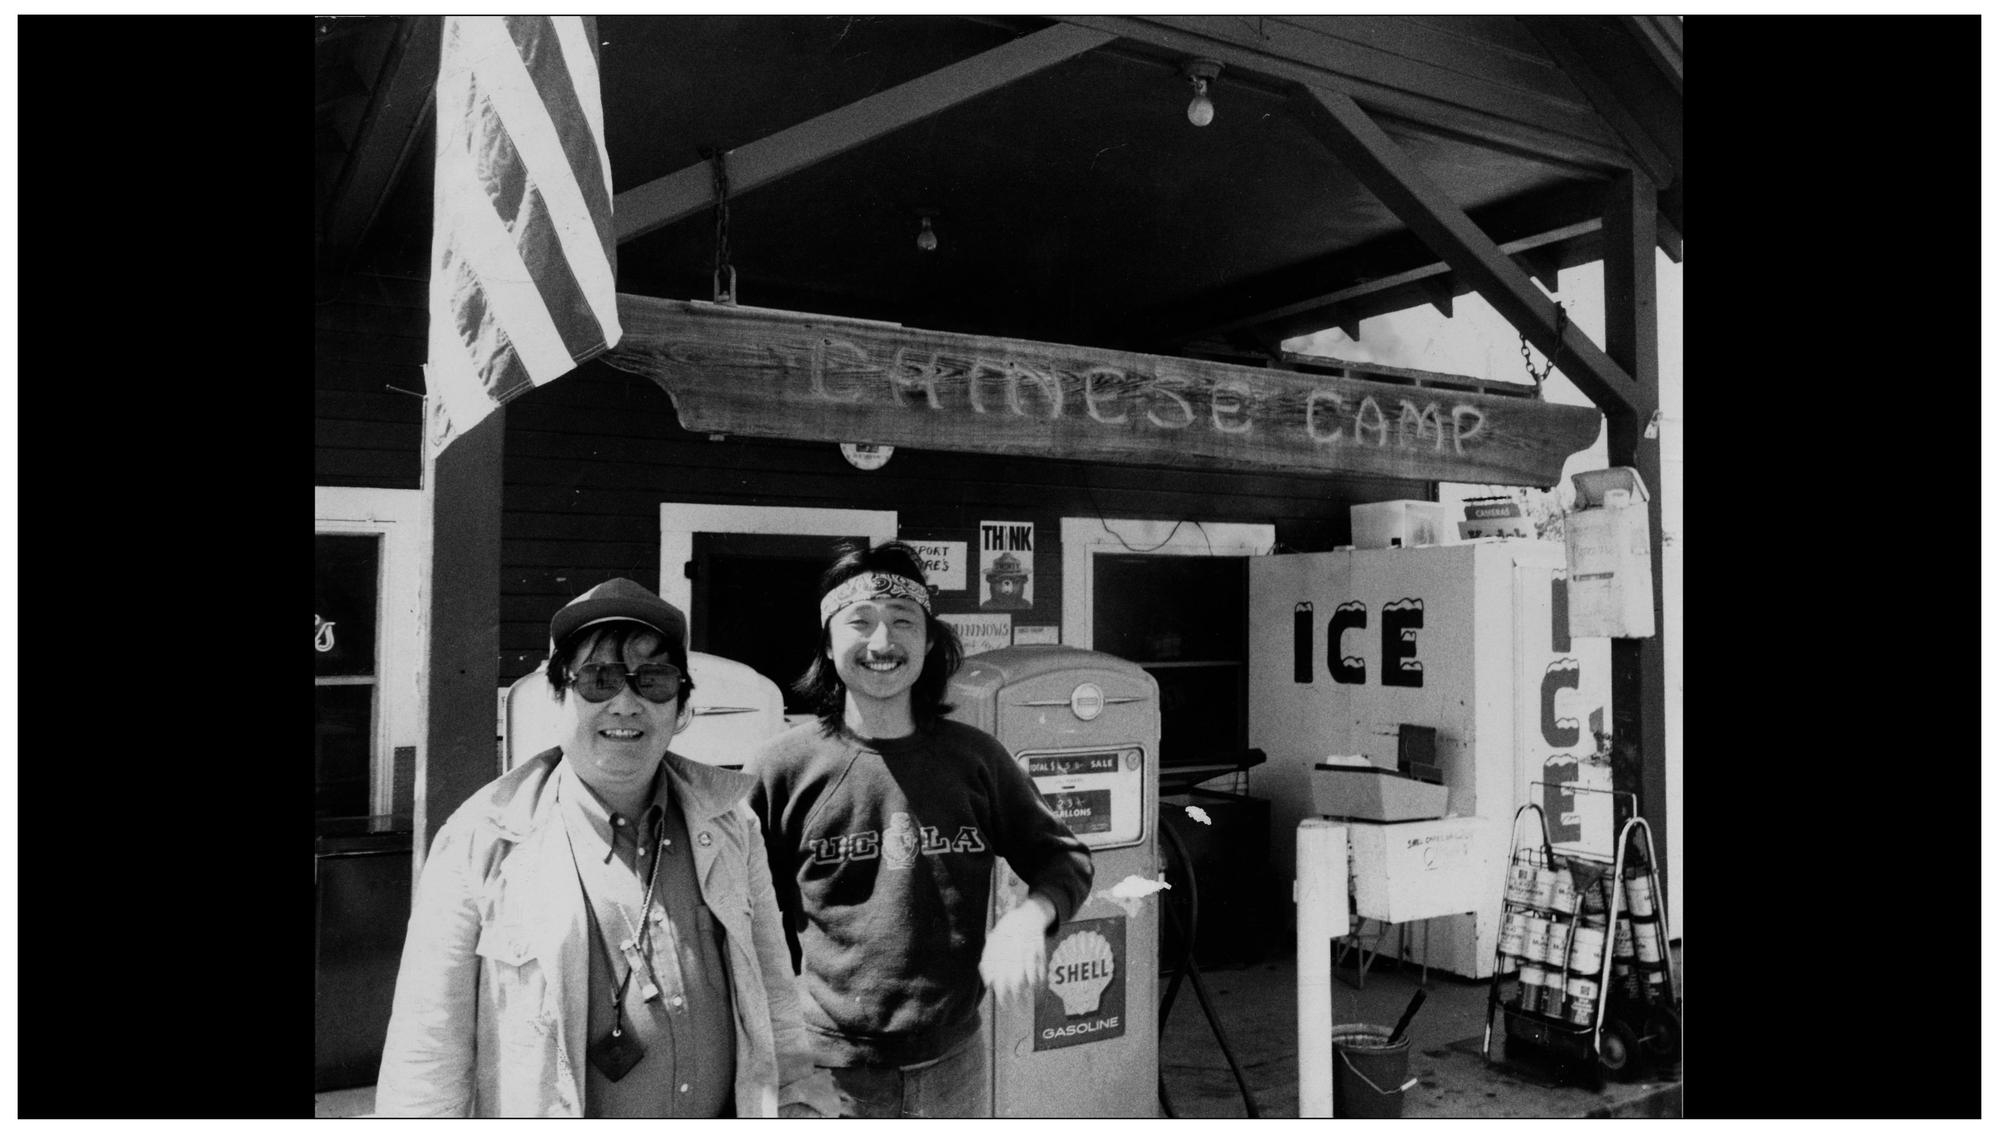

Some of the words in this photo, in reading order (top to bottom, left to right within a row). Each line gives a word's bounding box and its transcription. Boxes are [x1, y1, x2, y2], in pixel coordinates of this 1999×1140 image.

[811, 341, 1253, 434] CHINESE
[1306, 390, 1485, 455] CAMP
[982, 525, 1032, 551] THINK
[923, 558, 949, 572] RE'S
[1294, 597, 1424, 688] ICE
[1090, 759, 1113, 768] SALE
[1055, 959, 1109, 985] SHELL
[1042, 1016, 1119, 1039] GASOLINE
